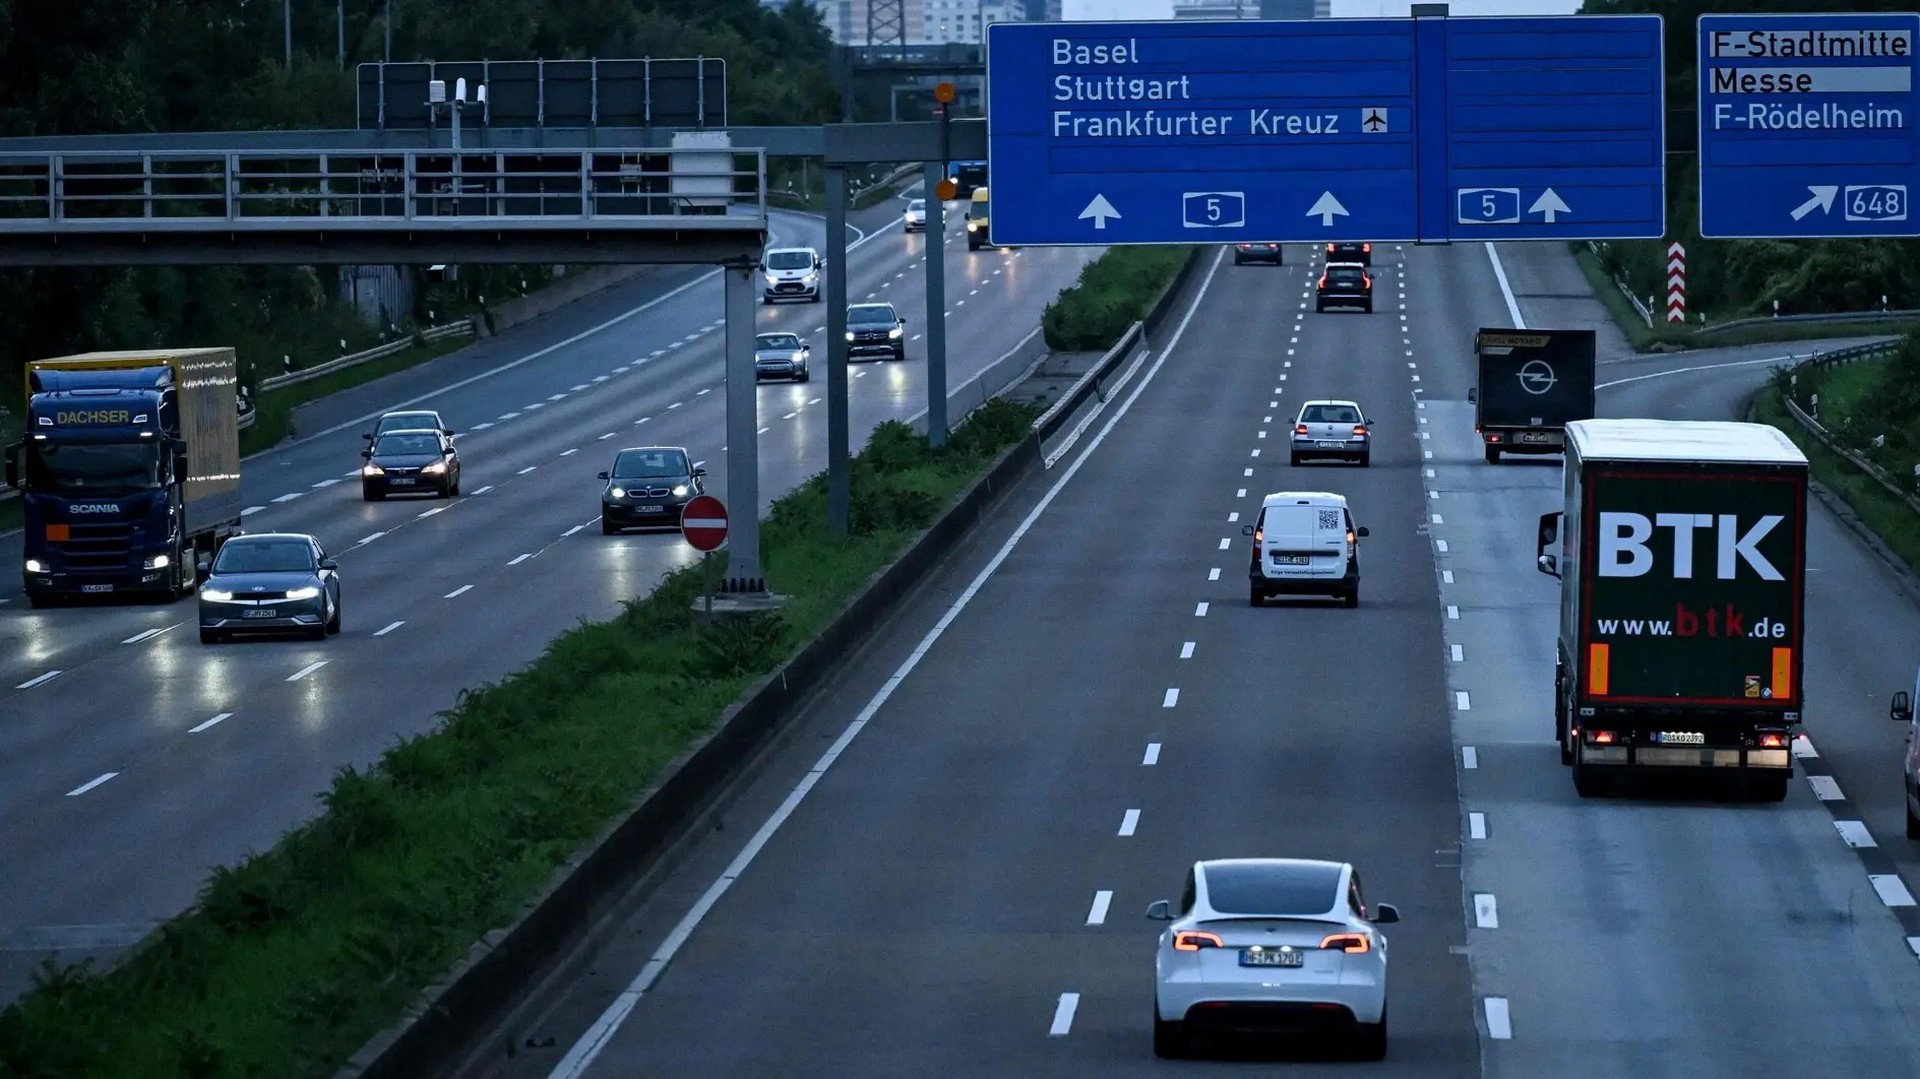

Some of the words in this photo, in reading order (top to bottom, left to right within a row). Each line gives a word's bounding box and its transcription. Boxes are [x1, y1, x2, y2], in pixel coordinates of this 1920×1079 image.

[1053, 38, 1139, 65] Basel
[1714, 31, 1908, 58] F-Stadtmitte
[1054, 75, 1190, 101] Stuttgart
[1714, 68, 1813, 94] Messe
[1054, 110, 1232, 137] Frankfurter
[1250, 108, 1340, 135] Kreuz
[1714, 104, 1903, 130] F-Rödelheim
[1207, 199, 1221, 221] 5
[1482, 195, 1496, 218] 5
[1852, 192, 1900, 215] 648
[57, 410, 129, 425] DACHSER
[69, 504, 120, 514] SCANIA
[1598, 511, 1786, 581] BTK
